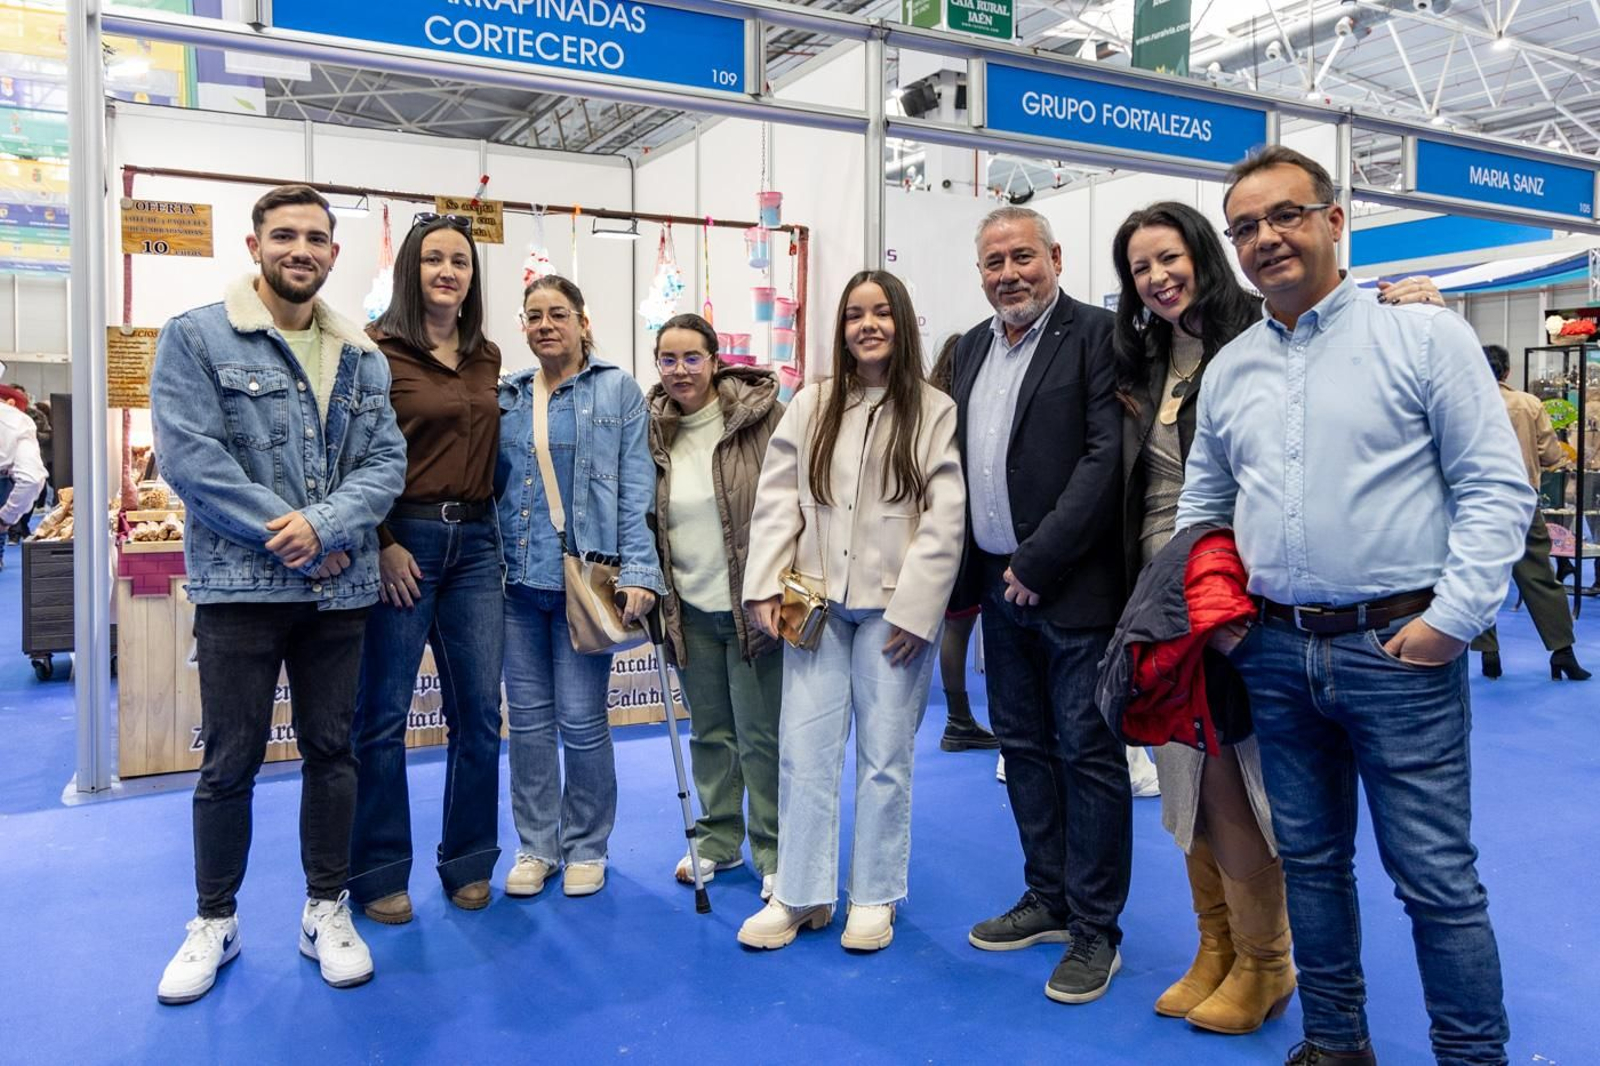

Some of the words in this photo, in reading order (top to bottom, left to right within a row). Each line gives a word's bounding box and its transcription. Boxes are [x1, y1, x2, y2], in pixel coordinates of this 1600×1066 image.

[447, 0, 646, 34] PINADAS
[976, 0, 1010, 17] RURAL
[968, 11, 993, 26] JAÉN
[424, 15, 624, 70] CORTECERO
[712, 69, 738, 86] 109
[1022, 91, 1096, 124] GRUPO
[1103, 103, 1212, 142] FORTALEZAS
[1469, 165, 1511, 190] MARIA
[1513, 173, 1545, 196] SANZ
[135, 202, 195, 214] OFERTA
[1579, 203, 1591, 213] 105
[144, 241, 168, 254] 10
